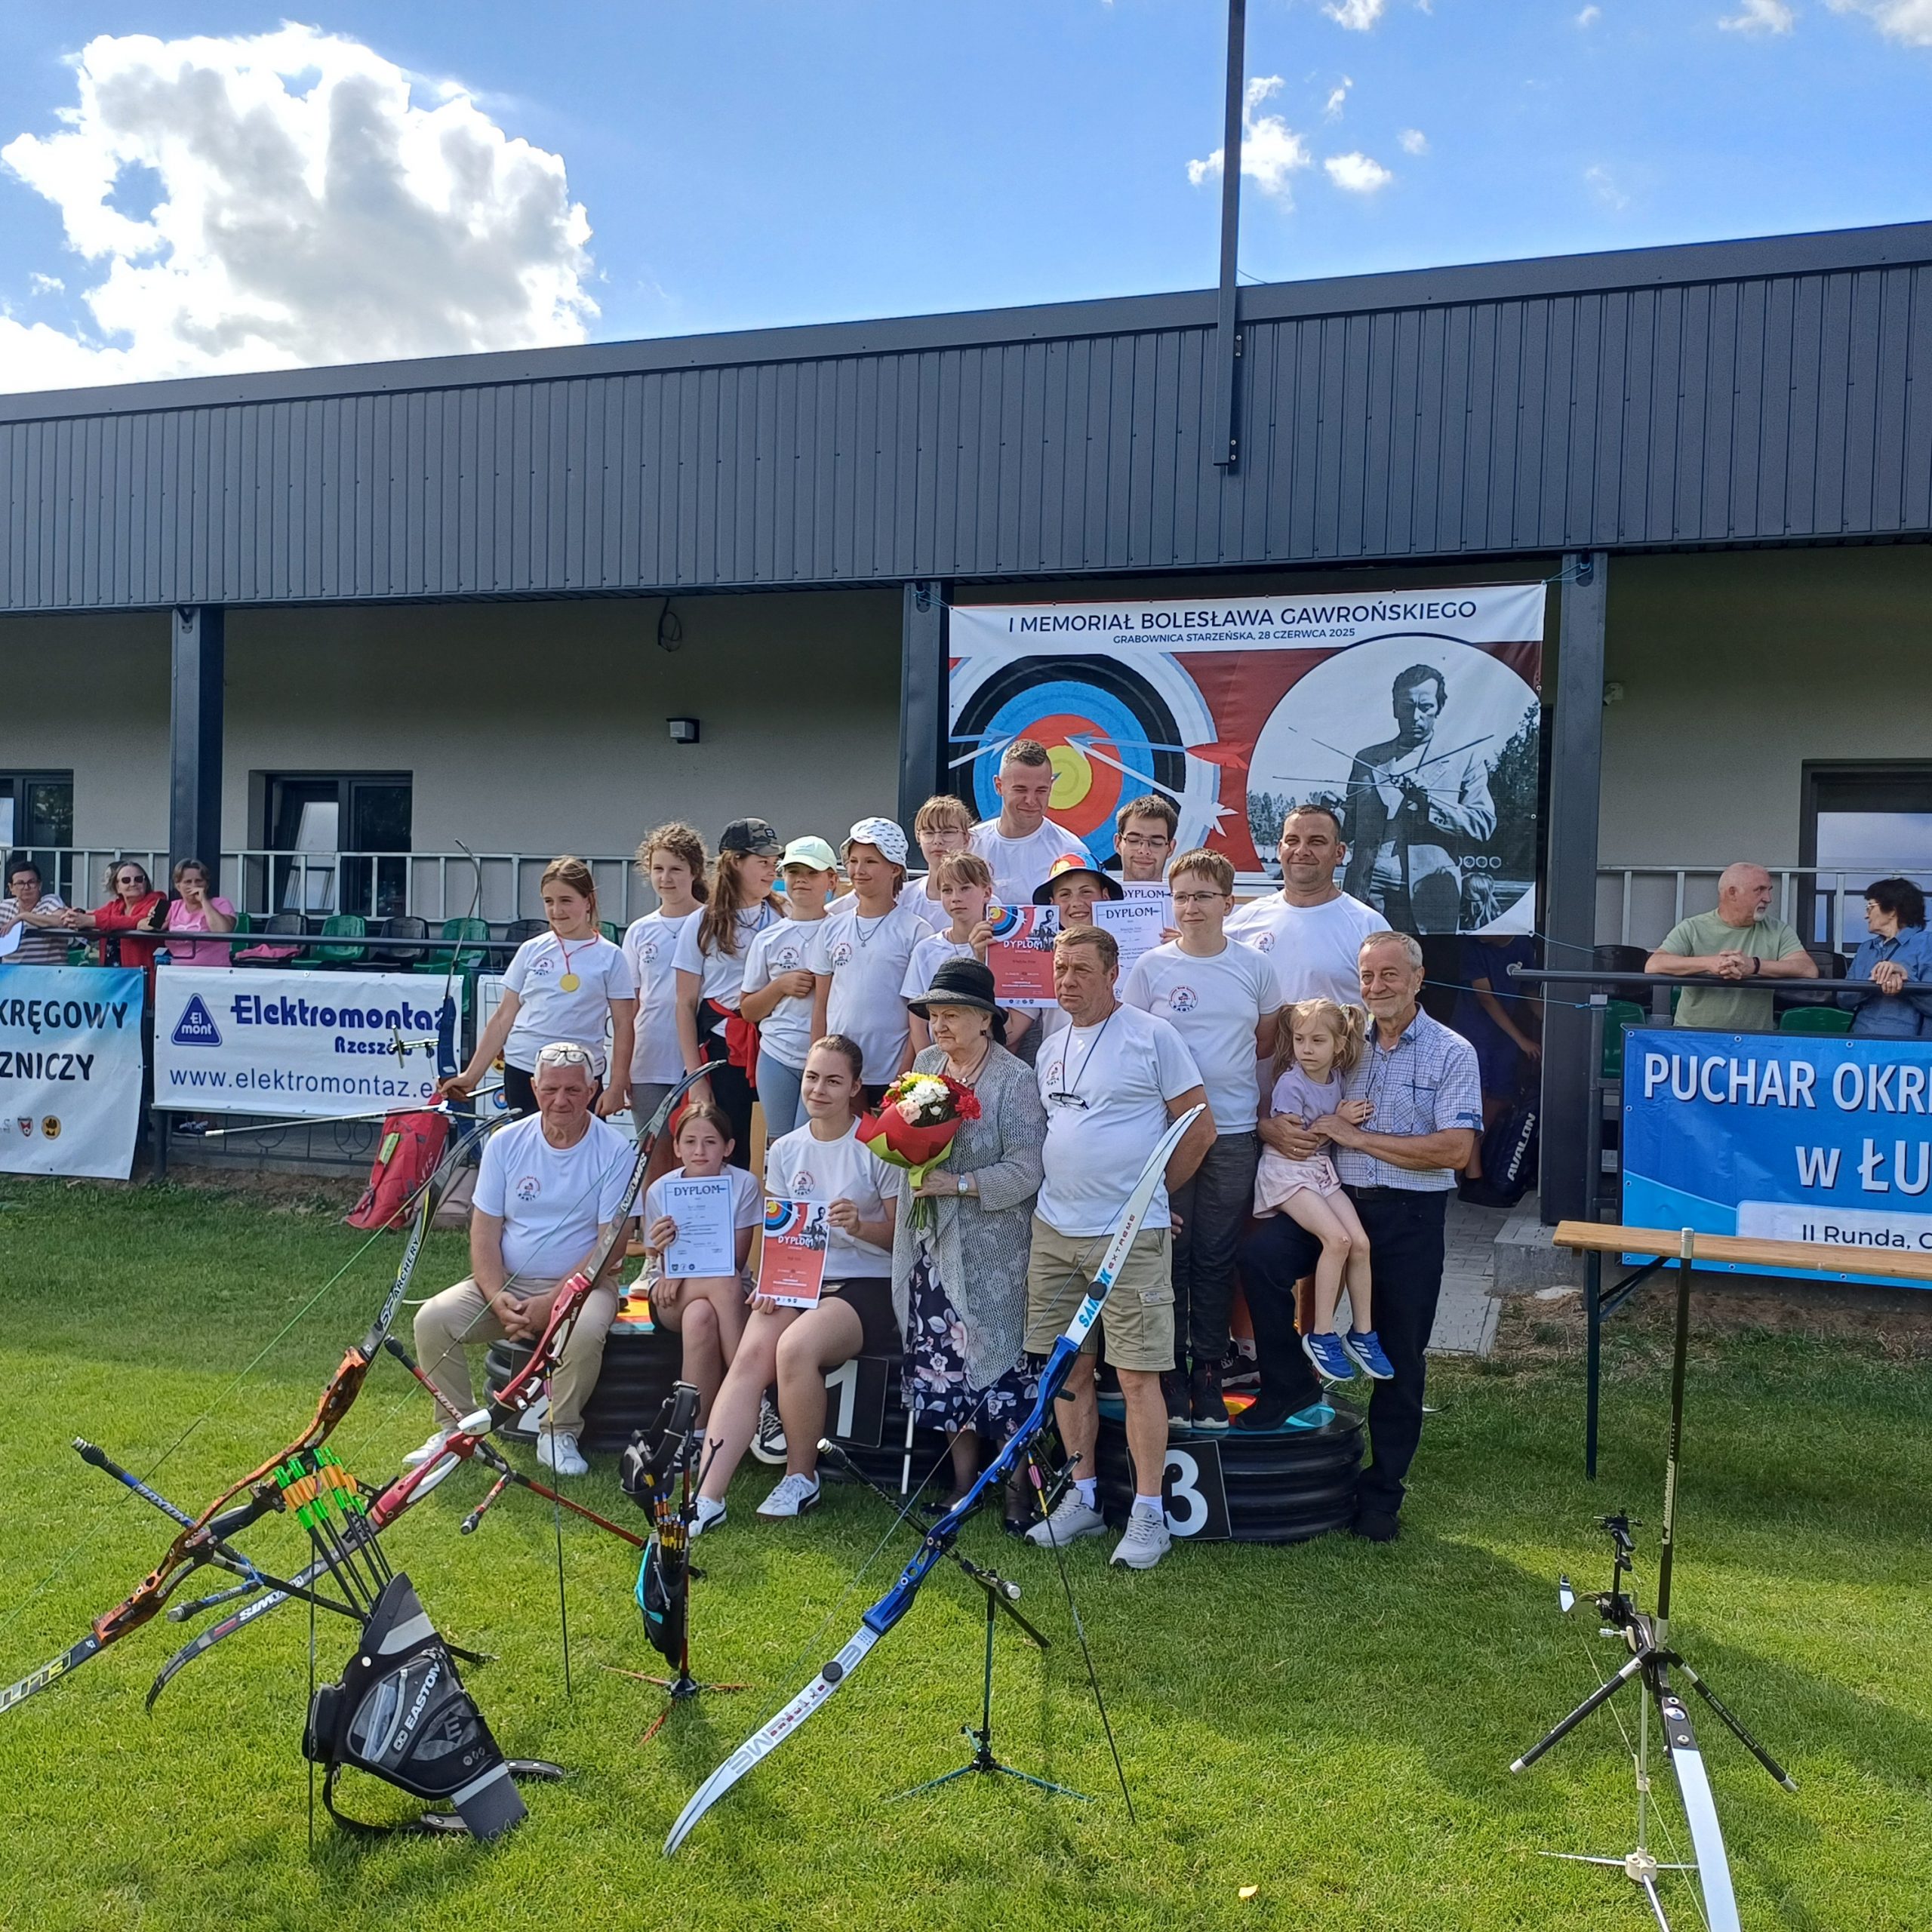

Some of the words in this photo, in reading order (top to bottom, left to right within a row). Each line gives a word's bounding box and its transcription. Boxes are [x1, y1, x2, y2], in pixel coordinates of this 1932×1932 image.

[1008, 617, 1014, 632] I
[1020, 614, 1134, 632] MEMORIAŁ
[1140, 608, 1274, 630] BOLESŁAWA
[1281, 601, 1477, 626] GAWROŃSKIEGO
[1113, 634, 1183, 644] GRABOWNICA
[1186, 629, 1256, 642] STARZEŃSKA,
[1258, 631, 1270, 640] 28
[1273, 629, 1326, 639] CZERWCA
[1330, 627, 1355, 638] 2025
[1106, 907, 1153, 919] DYPLOM
[1003, 940, 1043, 949] DYPLOM
[181, 1023, 212, 1035] mont
[0, 1051, 94, 1081] ZNICZY
[169, 1068, 432, 1098] www.elektromontaz.e
[1644, 1052, 1816, 1109] PUCHAR
[1832, 1061, 1932, 1114] OKR
[1507, 1112, 1536, 1181] AVALON
[1857, 1138, 1930, 1195] ŁU
[673, 1185, 720, 1197] DYPLOM
[778, 1236, 814, 1247] DYPLOM
[1823, 1225, 1911, 1250] Runda,
[394, 1236, 420, 1300] ARCHERY
[1078, 1267, 1113, 1328] SAK
[824, 1358, 859, 1438] 1
[1162, 1449, 1208, 1537] 3
[404, 1661, 441, 1730] EASTON
[728, 1644, 863, 1775] ETREME
